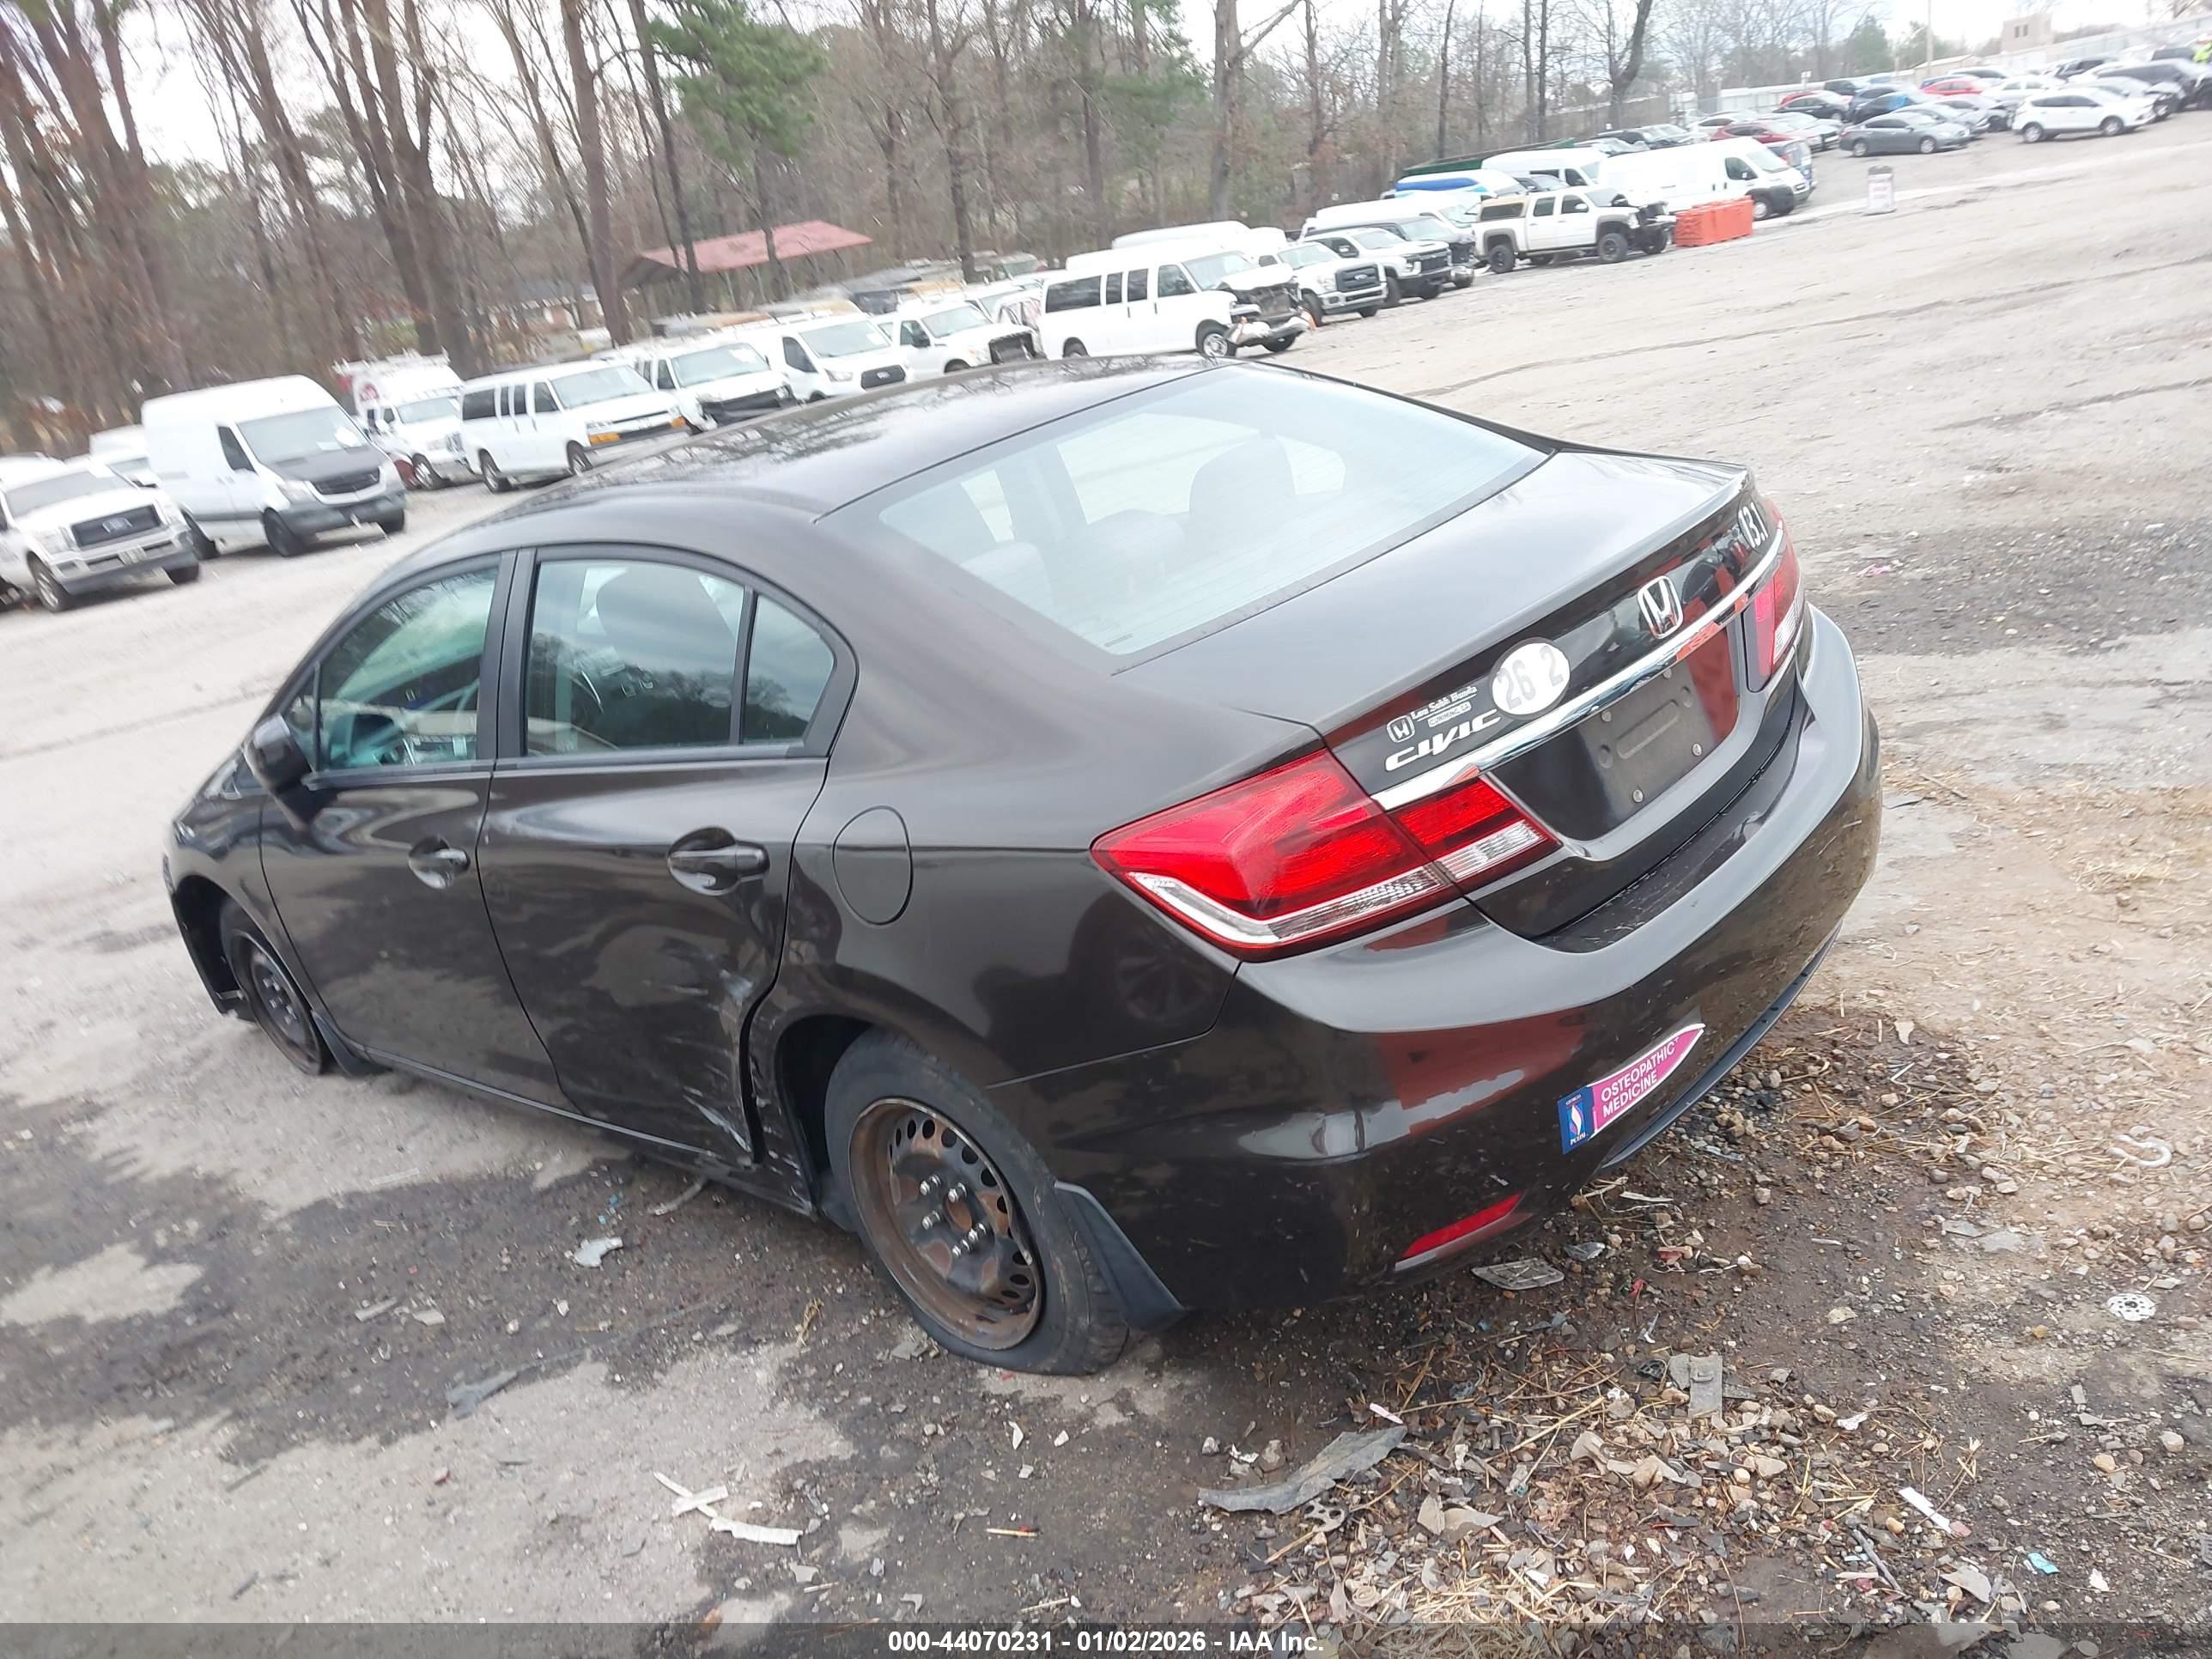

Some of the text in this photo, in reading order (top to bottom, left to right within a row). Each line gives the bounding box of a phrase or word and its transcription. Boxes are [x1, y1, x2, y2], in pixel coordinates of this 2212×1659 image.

[1738, 501, 1768, 548] 13.1
[1385, 708, 1501, 771] CIVIC
[1602, 1070, 1657, 1118] MEDICINE
